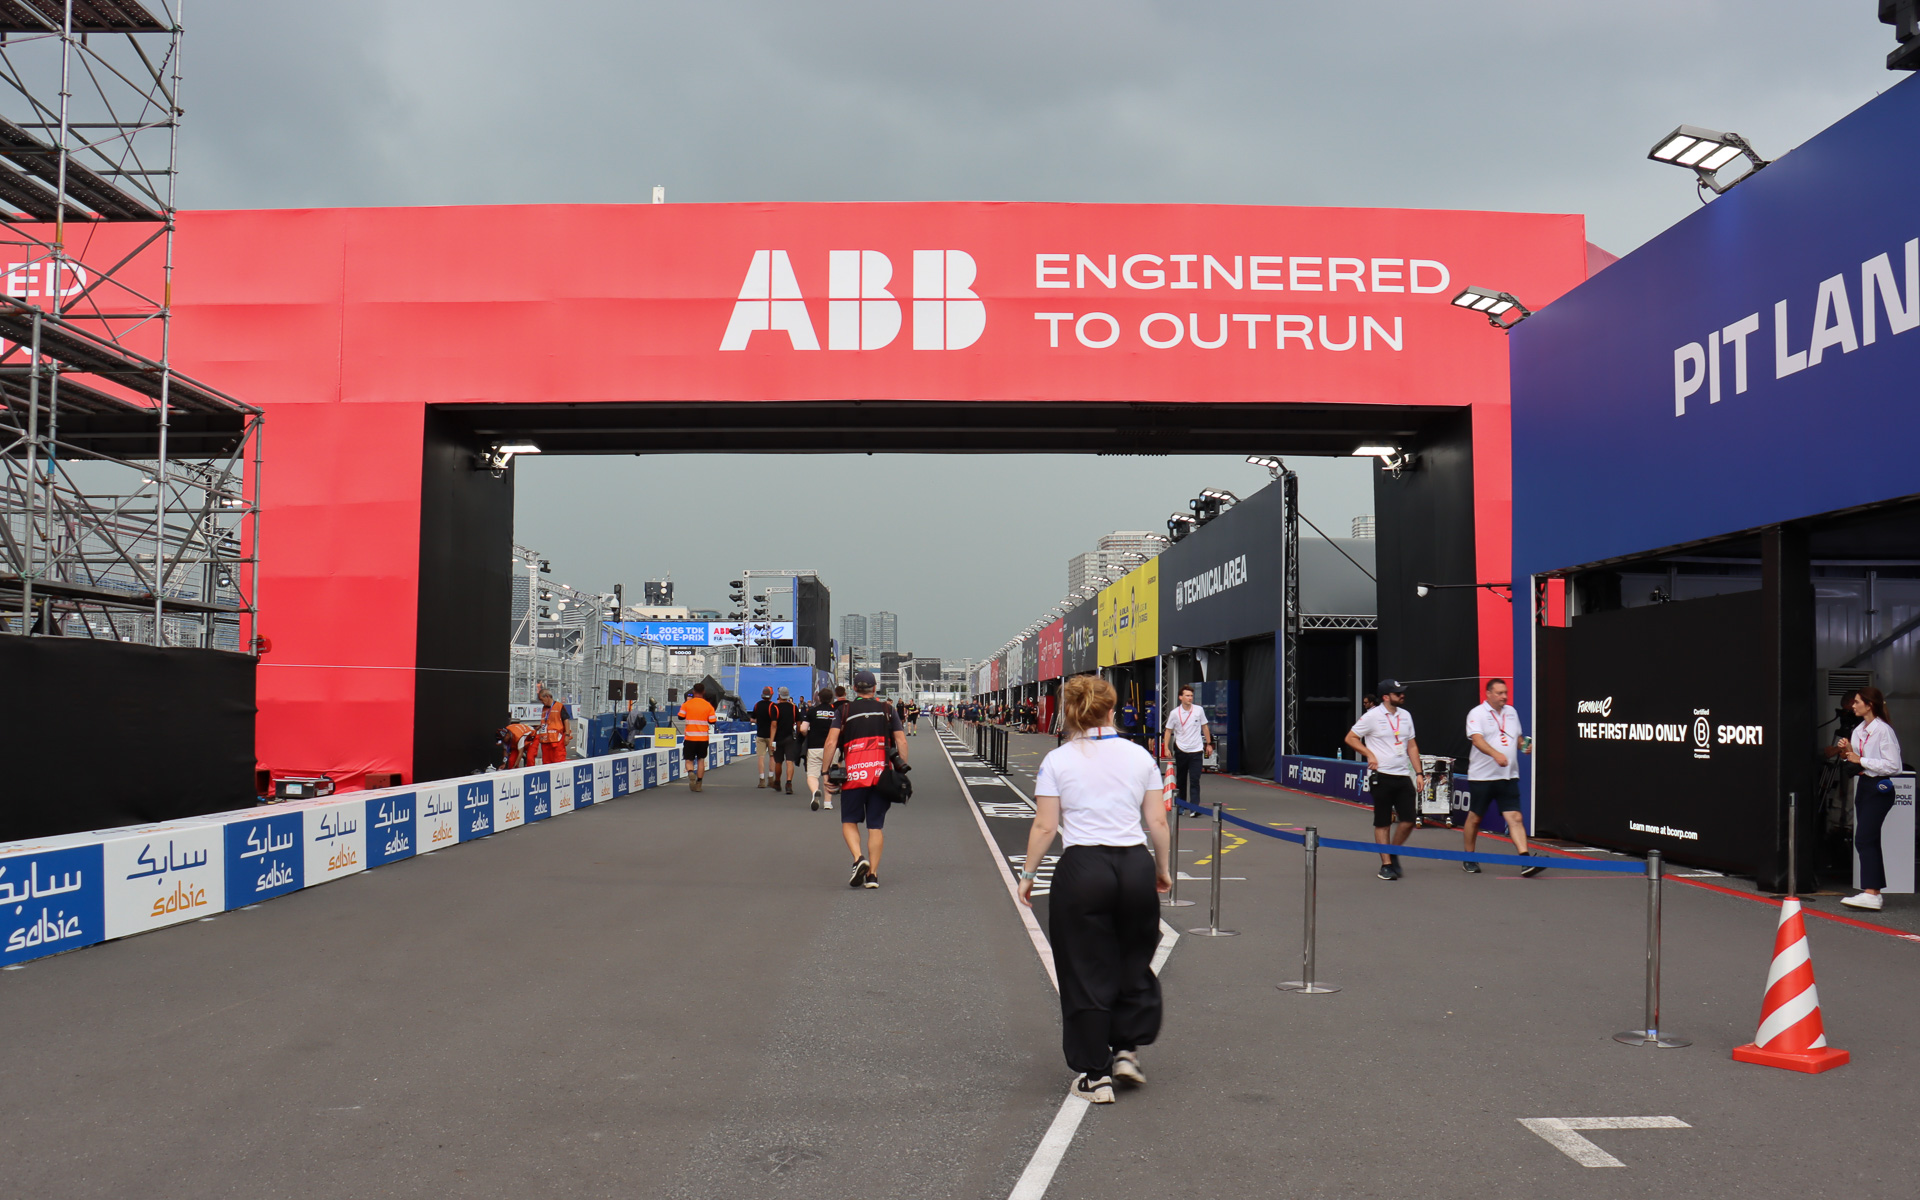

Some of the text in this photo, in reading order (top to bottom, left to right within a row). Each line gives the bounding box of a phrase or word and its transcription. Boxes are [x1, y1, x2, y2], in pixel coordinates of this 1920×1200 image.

[0, 262, 87, 297] ED
[1035, 253, 1451, 295] ENGINEERED
[719, 249, 987, 352] ABB
[1034, 311, 1404, 352] TO OUTRUN
[1674, 237, 1920, 418] PIT LAN
[1184, 565, 1223, 605] TECHNICAL
[1223, 554, 1248, 590] AREA
[659, 626, 704, 634] 2026 TDK
[713, 627, 731, 635] ABB
[1577, 722, 1597, 738] THE
[1598, 723, 1629, 740] FIRST
[1629, 724, 1654, 741] AND
[1655, 724, 1687, 742] ONLY
[1288, 764, 1327, 784] PIT BOOST
[1344, 773, 1358, 789] PIT
[424, 794, 452, 822] سابك
[463, 787, 489, 814] سابك
[505, 804, 520, 823] sabic
[534, 797, 548, 816] sabic
[315, 811, 357, 846] سابك
[374, 801, 410, 832] سابك
[471, 811, 489, 832] sabic
[1629, 820, 1698, 840] Learn more at bcorp.com
[240, 823, 293, 864] سابك
[384, 830, 410, 856] sabic
[431, 820, 453, 843] sabic
[126, 840, 207, 885] سابك
[327, 843, 357, 871] sabic
[255, 859, 294, 892] sabic
[150, 880, 208, 917] sabic
[5, 907, 83, 952] sabic
